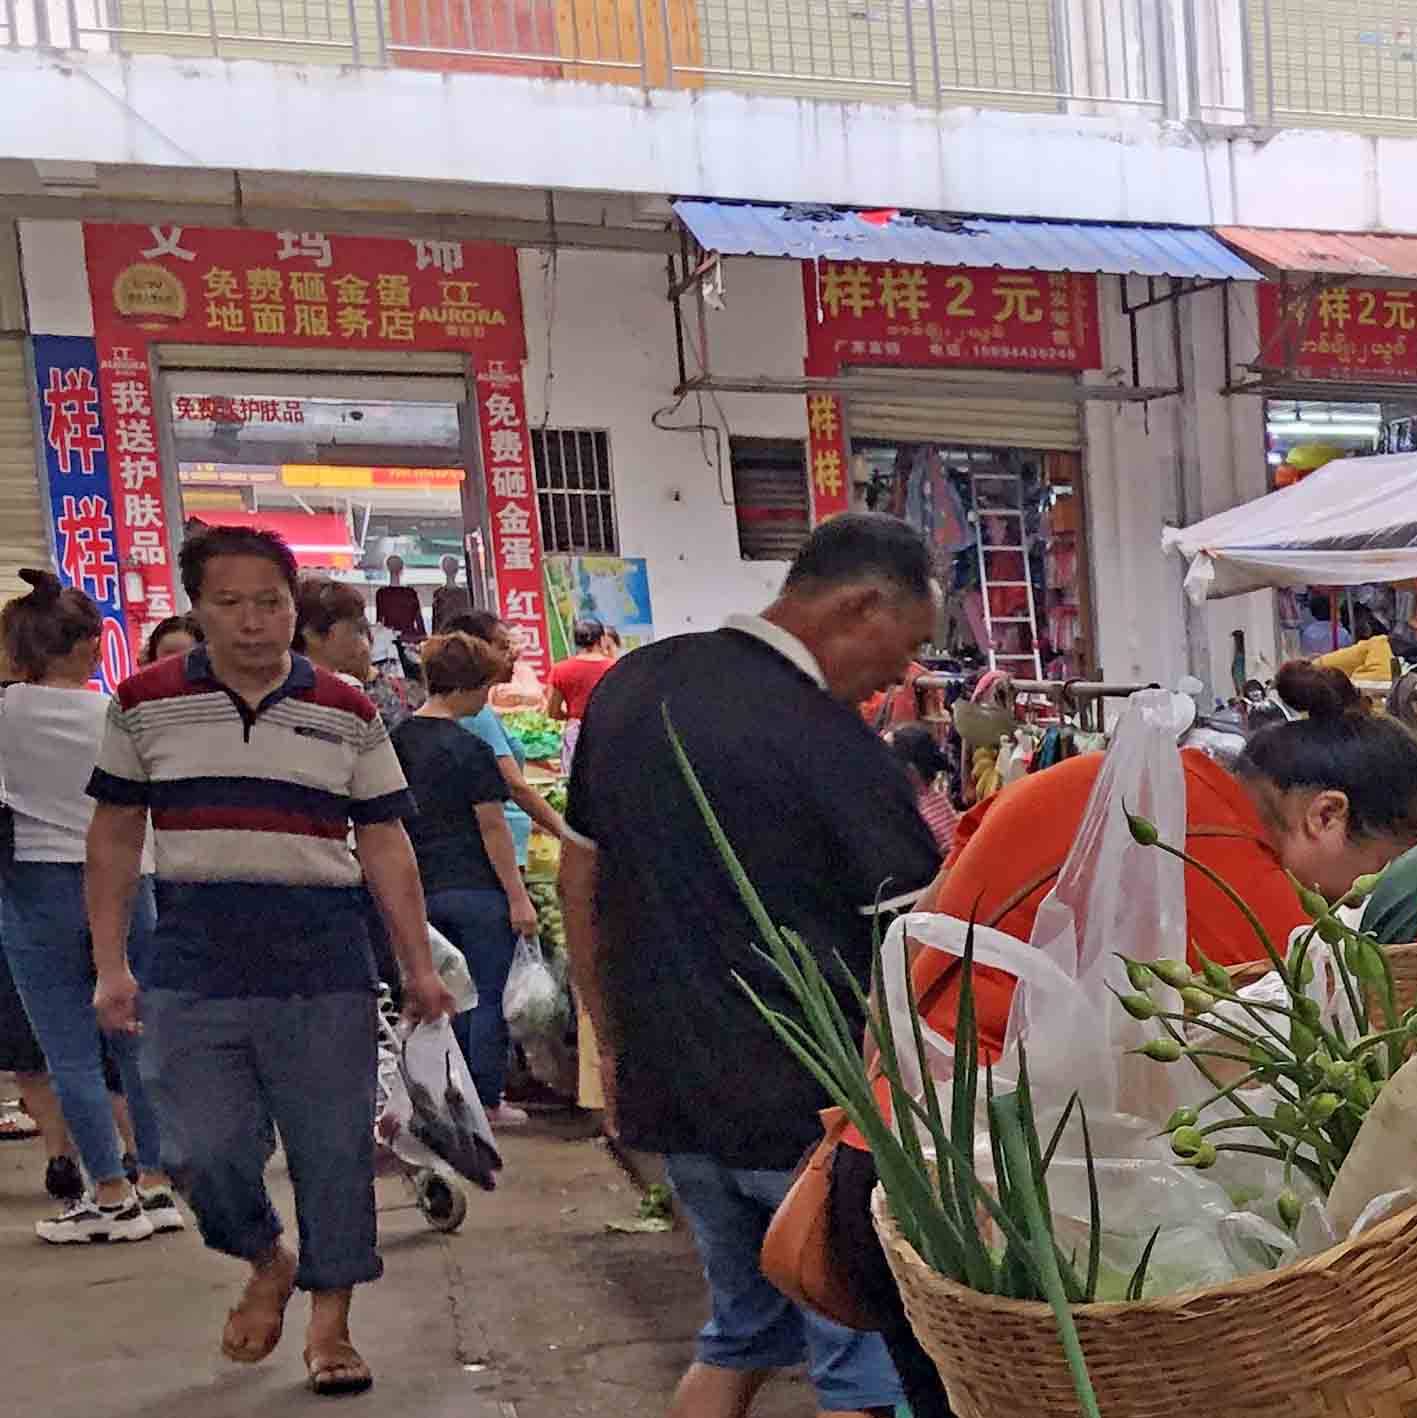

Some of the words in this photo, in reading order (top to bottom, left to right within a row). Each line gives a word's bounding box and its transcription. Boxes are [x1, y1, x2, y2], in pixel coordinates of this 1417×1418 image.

[202, 266, 411, 306] 免费砸金蛋
[820, 265, 1042, 322] 样样2元
[207, 303, 416, 341] 地面服务店
[111, 380, 168, 565] 我送护肤品
[485, 394, 534, 571] 免费砸金蛋
